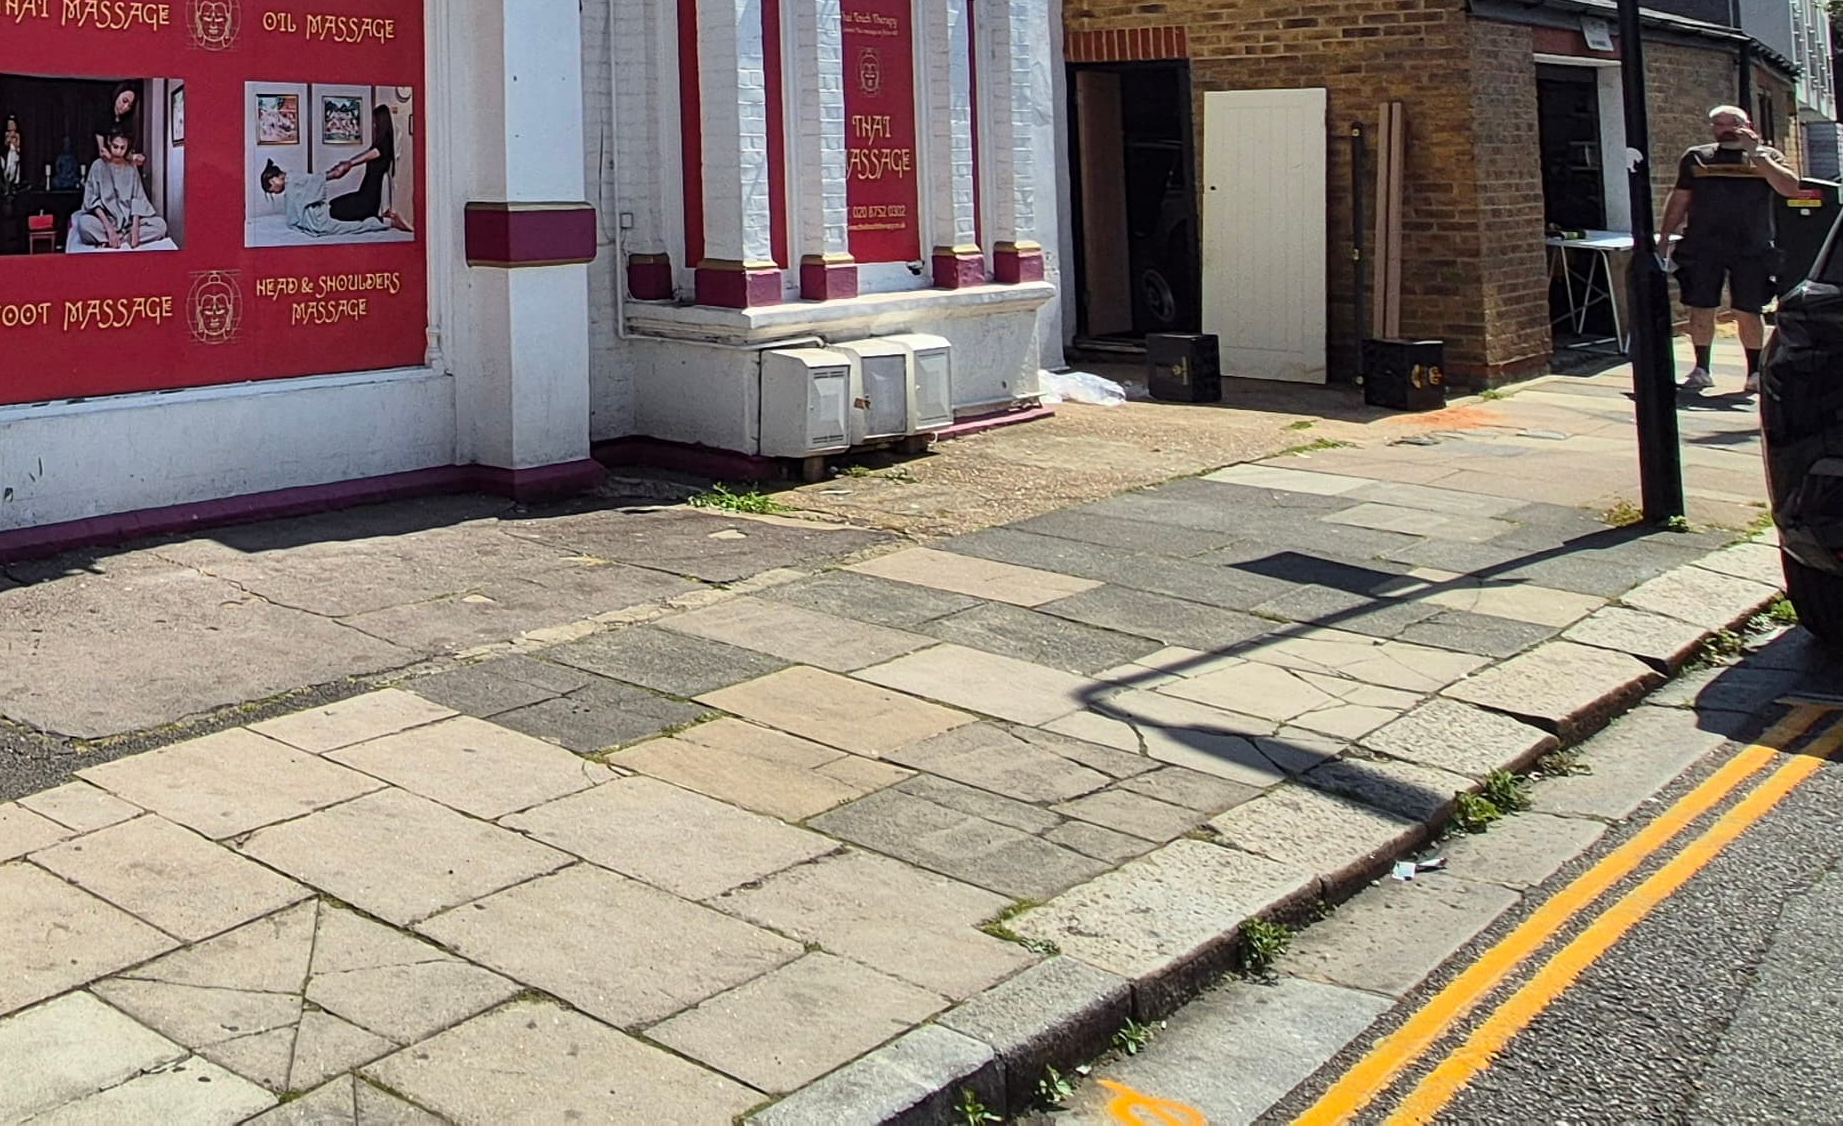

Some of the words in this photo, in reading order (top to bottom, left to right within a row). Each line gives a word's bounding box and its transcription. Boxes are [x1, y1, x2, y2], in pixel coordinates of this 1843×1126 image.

[263, 11, 296, 32] OIL
[306, 13, 395, 43] MASSAGE
[852, 115, 892, 146] THAI
[853, 206, 867, 219] 020
[868, 205, 887, 218] 8752
[888, 205, 906, 217] 0302
[256, 276, 299, 296] HEAD
[301, 278, 314, 294] &
[316, 272, 400, 299] SHOULDERS
[63, 296, 174, 331] MASSAGE
[291, 297, 367, 325] MASSAGE
